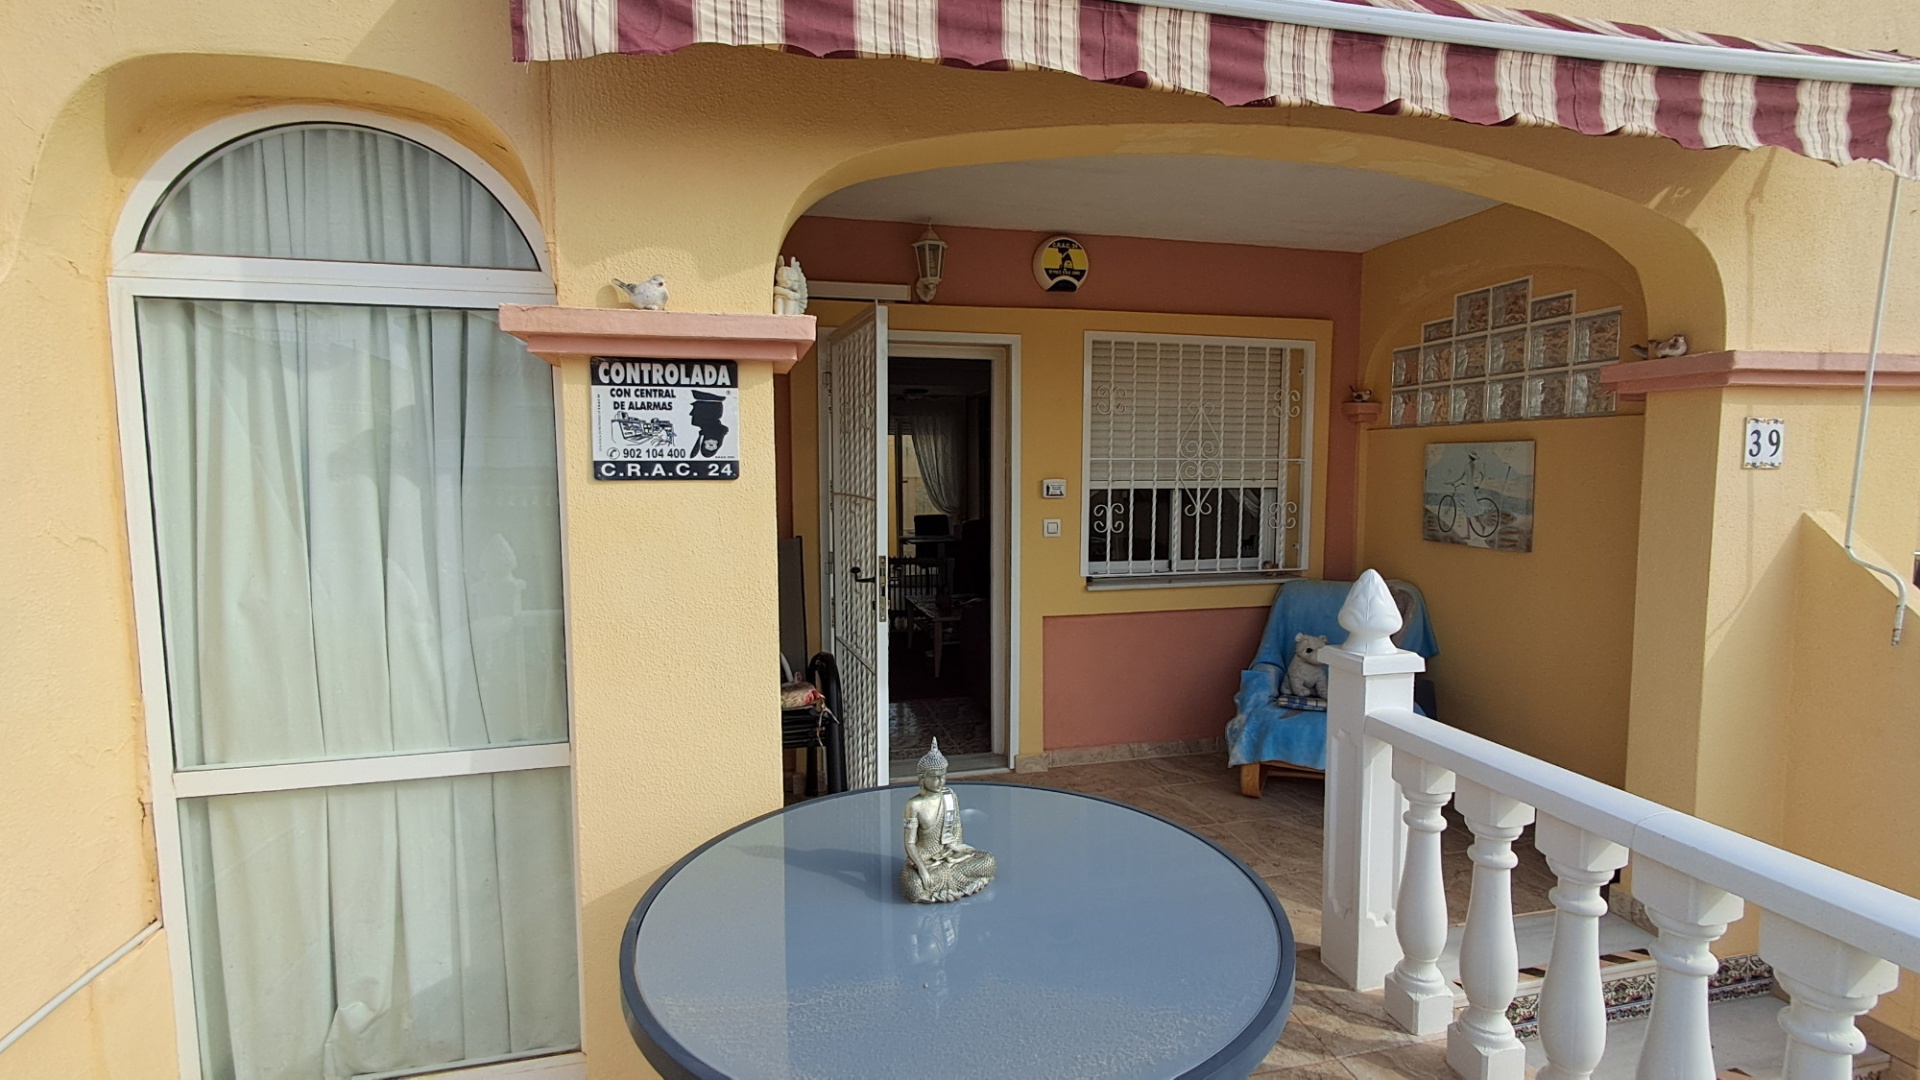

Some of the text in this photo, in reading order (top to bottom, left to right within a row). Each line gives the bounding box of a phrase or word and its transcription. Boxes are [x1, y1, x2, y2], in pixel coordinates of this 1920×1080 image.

[598, 361, 731, 386] CONTROLADA
[610, 388, 676, 399] CON CENTRAL
[613, 401, 673, 411] DE ALARMAS
[1748, 429, 1781, 457] 39
[623, 448, 686, 459] 902 104 400
[601, 463, 733, 477] C.R.A.C. 24
